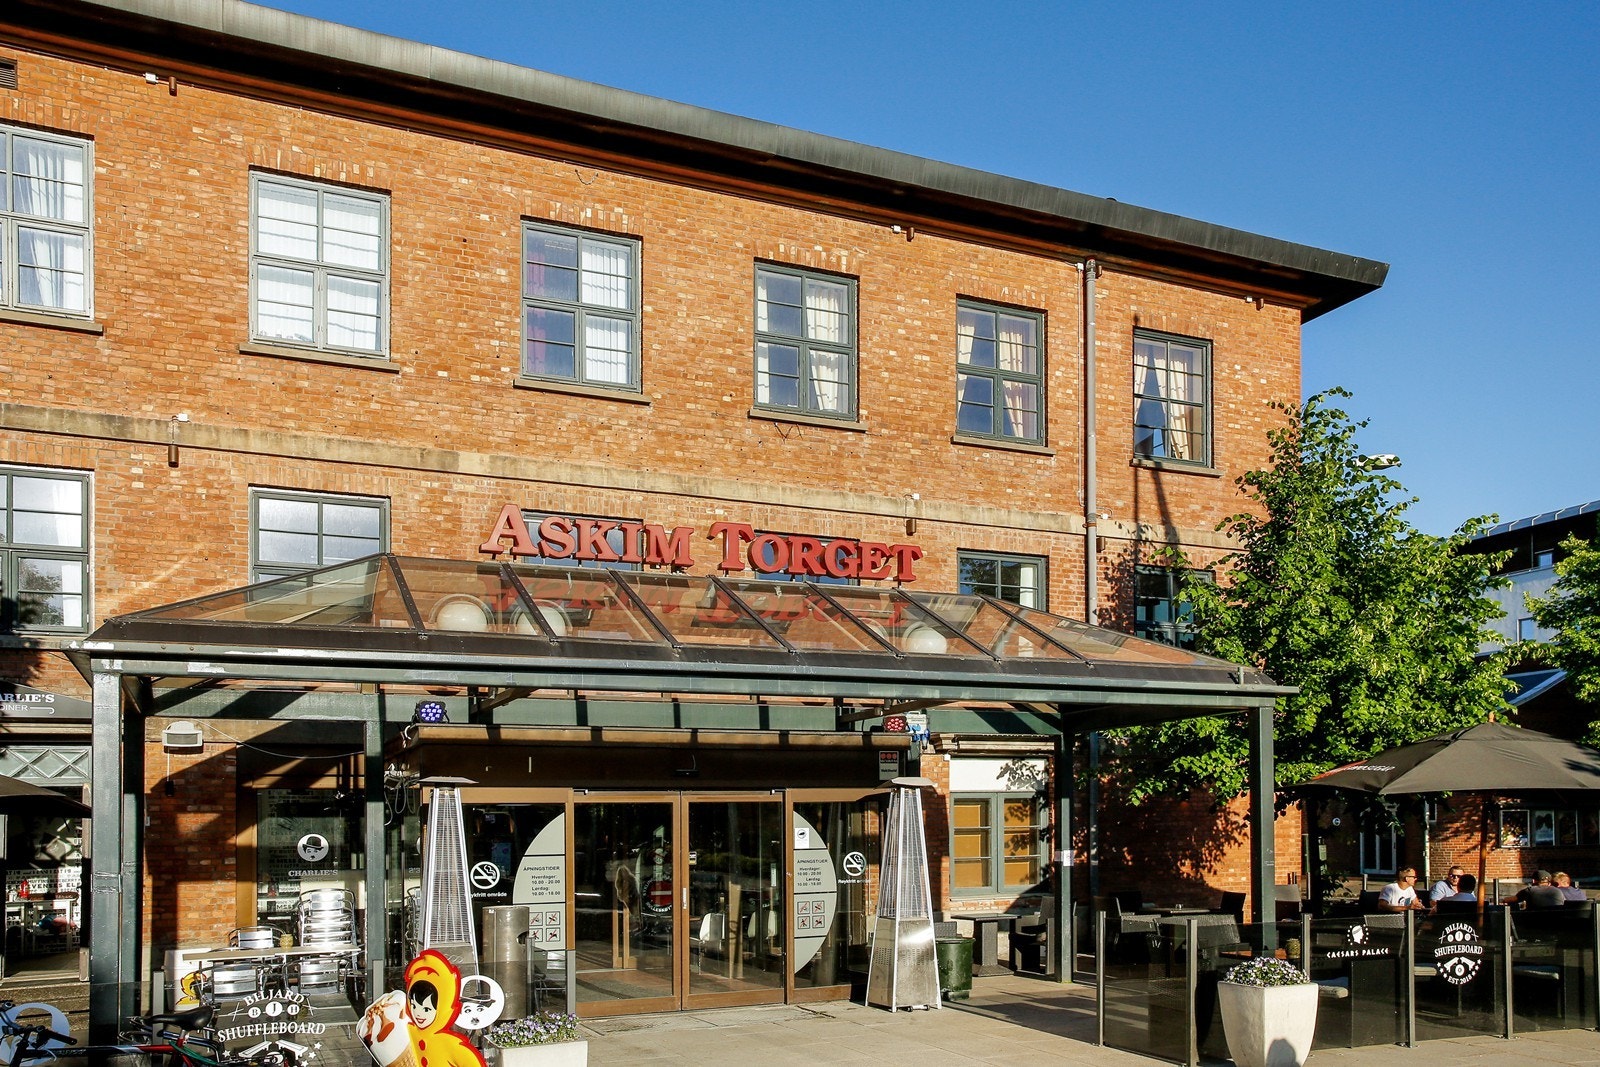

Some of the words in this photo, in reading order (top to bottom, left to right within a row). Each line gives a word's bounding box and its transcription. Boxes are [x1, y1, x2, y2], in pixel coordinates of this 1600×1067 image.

[288, 869, 338, 877] CHARLIE'S
[1444, 922, 1473, 934] BILJARD
[1326, 949, 1359, 959] CAESARS
[1362, 947, 1389, 956] PALACE
[1434, 944, 1483, 958] SHUFFLEBOARD
[1447, 975, 1459, 985] EST
[243, 988, 305, 1007] BILJARD
[217, 1021, 326, 1043] SHUFFLEBOARD
